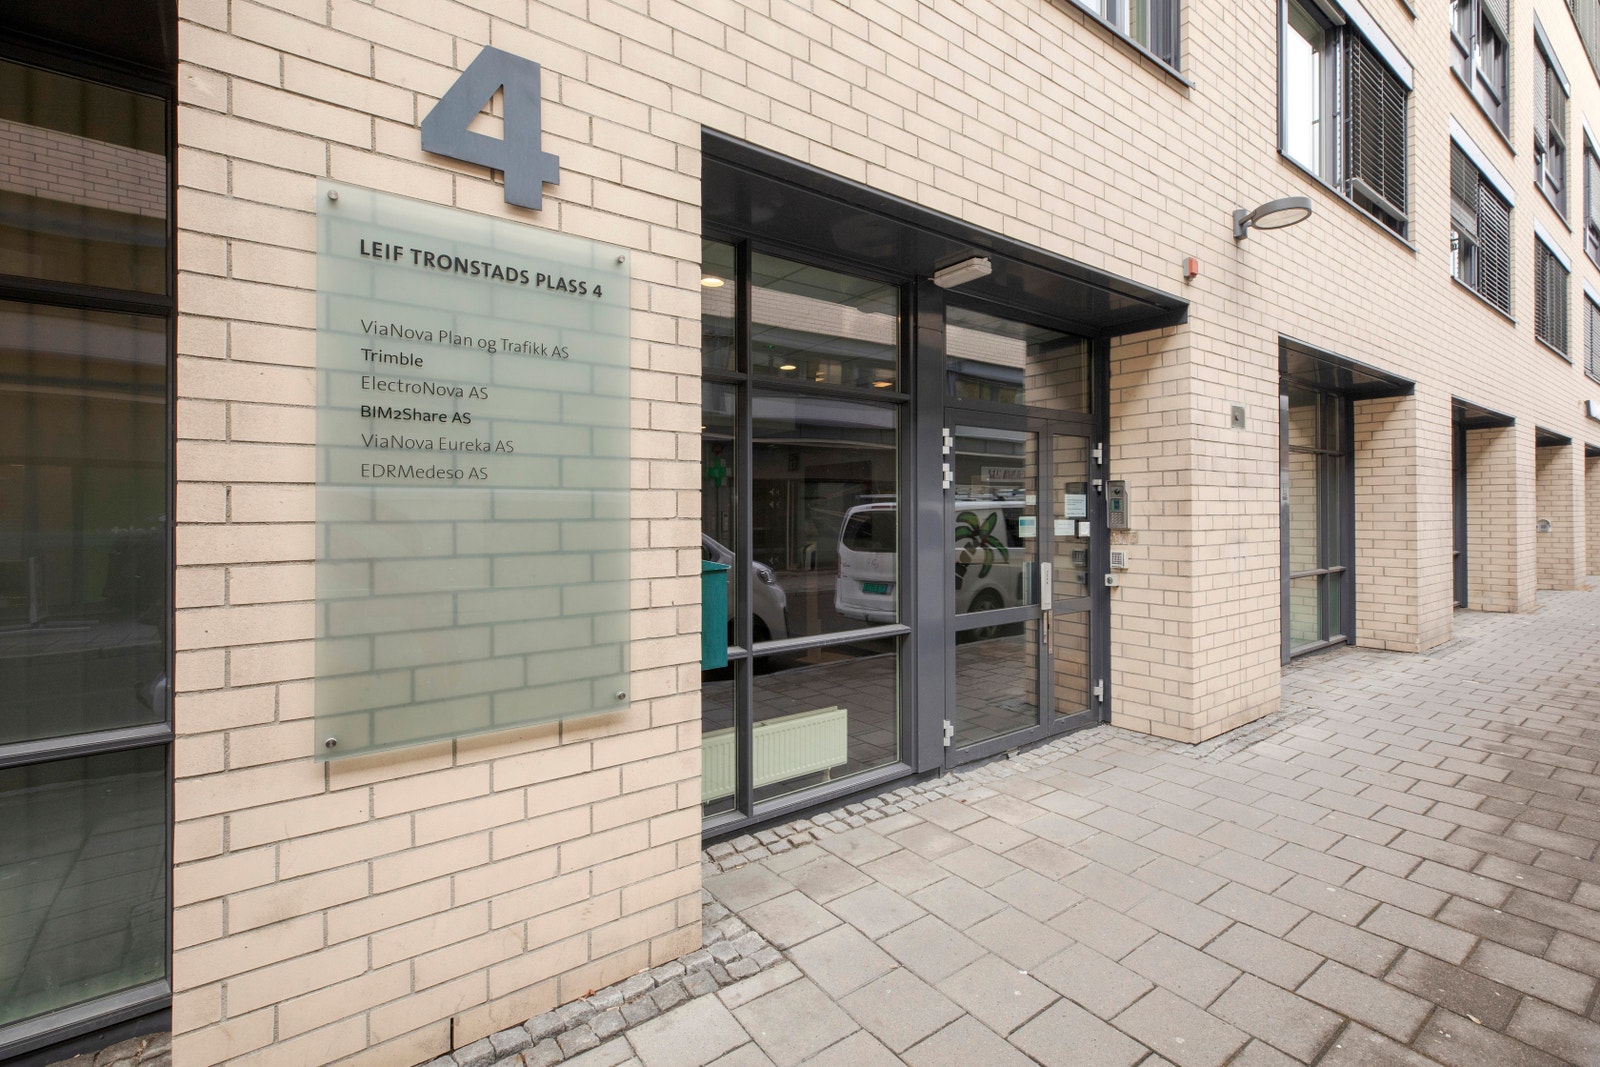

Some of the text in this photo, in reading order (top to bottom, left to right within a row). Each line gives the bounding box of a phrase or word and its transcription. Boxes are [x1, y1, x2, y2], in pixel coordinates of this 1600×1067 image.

[421, 45, 560, 211] 4
[360, 239, 603, 298] LEIF TRONSTADS PLASS 4
[360, 319, 570, 359] ViaNova Plan og Trafikk AS
[360, 348, 424, 368] Trimble
[361, 375, 489, 400] ElectroNova AS
[360, 405, 472, 425] BIM2Share AS
[361, 433, 515, 453] ViaNova Eureka AS
[361, 463, 489, 480] EDRMedeso AS
